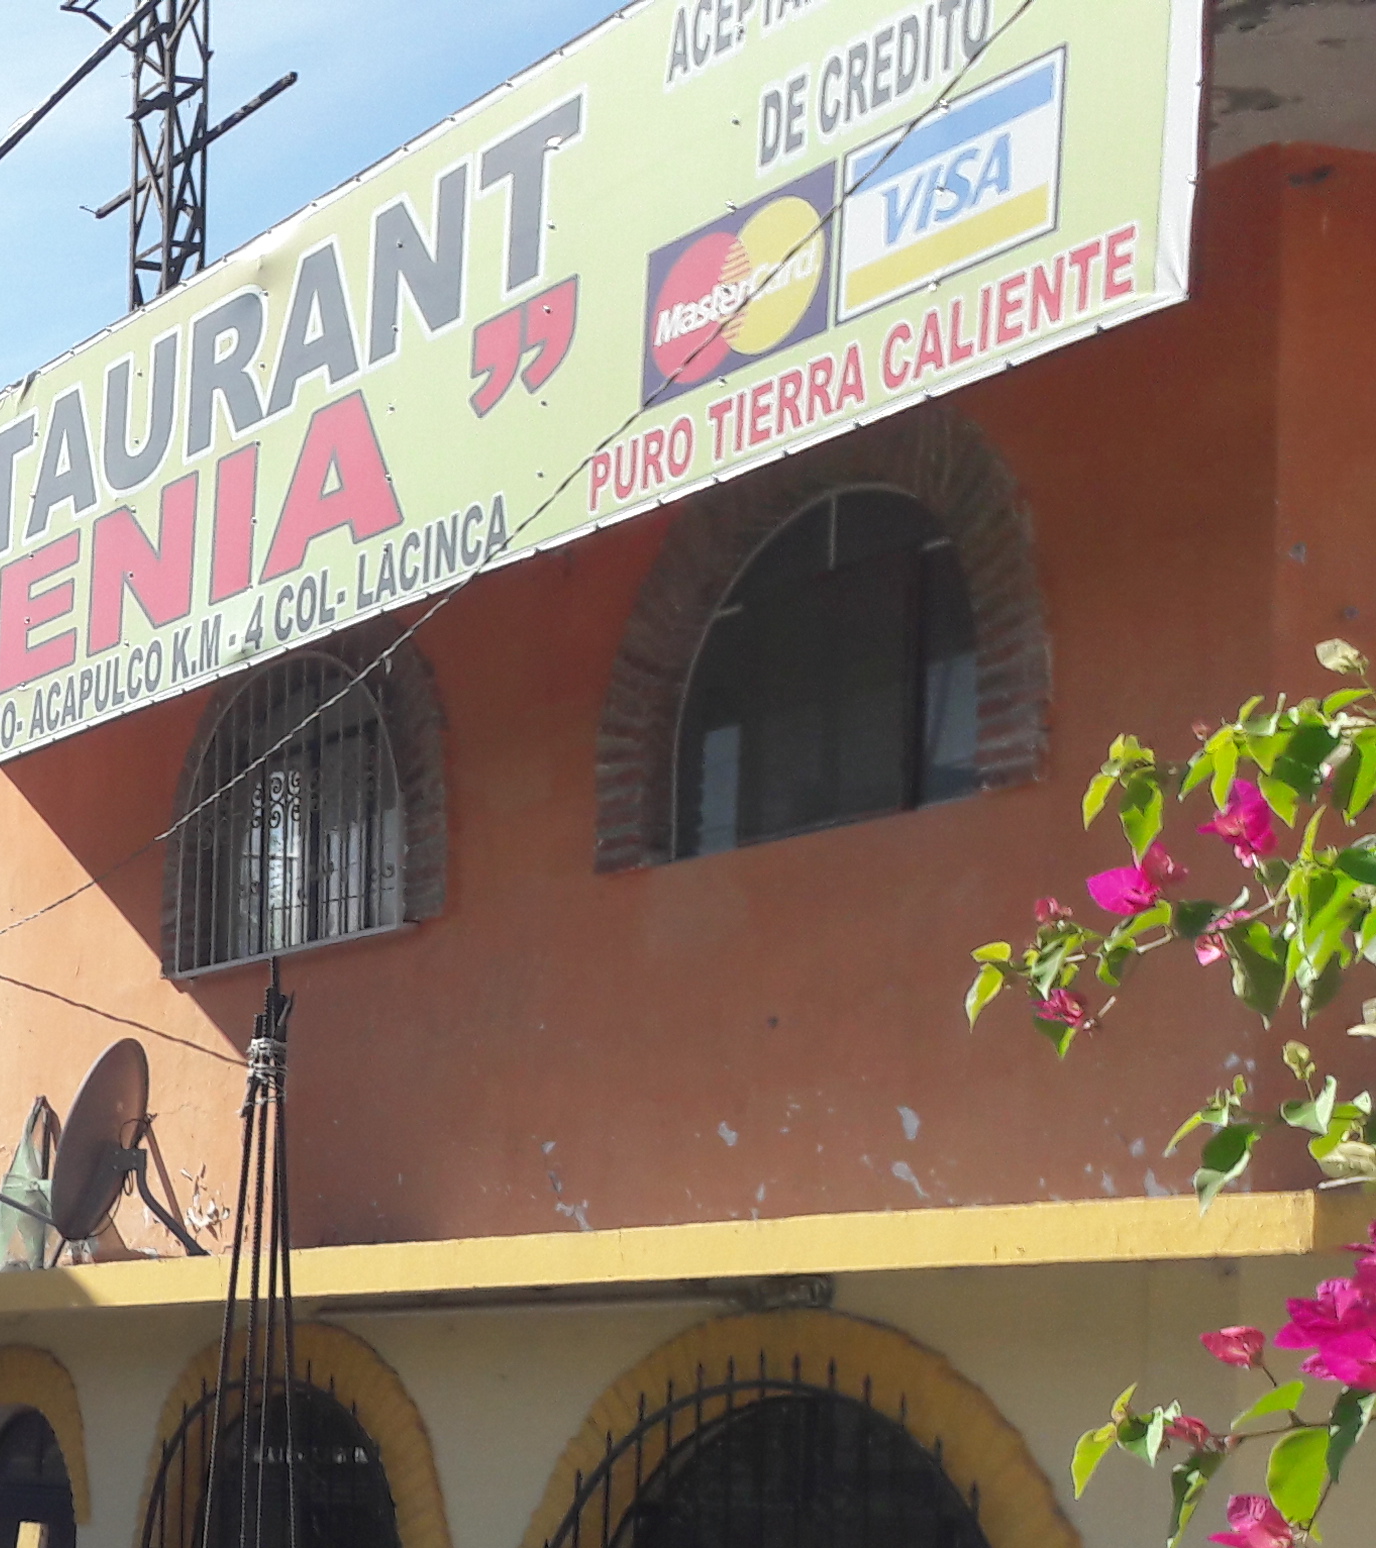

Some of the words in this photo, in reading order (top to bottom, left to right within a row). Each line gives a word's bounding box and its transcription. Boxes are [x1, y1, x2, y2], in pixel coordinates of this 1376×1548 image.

[666, 0, 811, 83] ACEP
[759, 74, 807, 167] DE
[819, 0, 990, 134] CREDITO
[883, 133, 1012, 246] VISA
[653, 239, 819, 347] MasterCard
[589, 416, 693, 511] PURO
[708, 346, 863, 461] TIERRA
[882, 225, 1136, 389] CALIENTE
[29, 639, 163, 740] ACAPULCO
[356, 494, 508, 609] LACINCA
